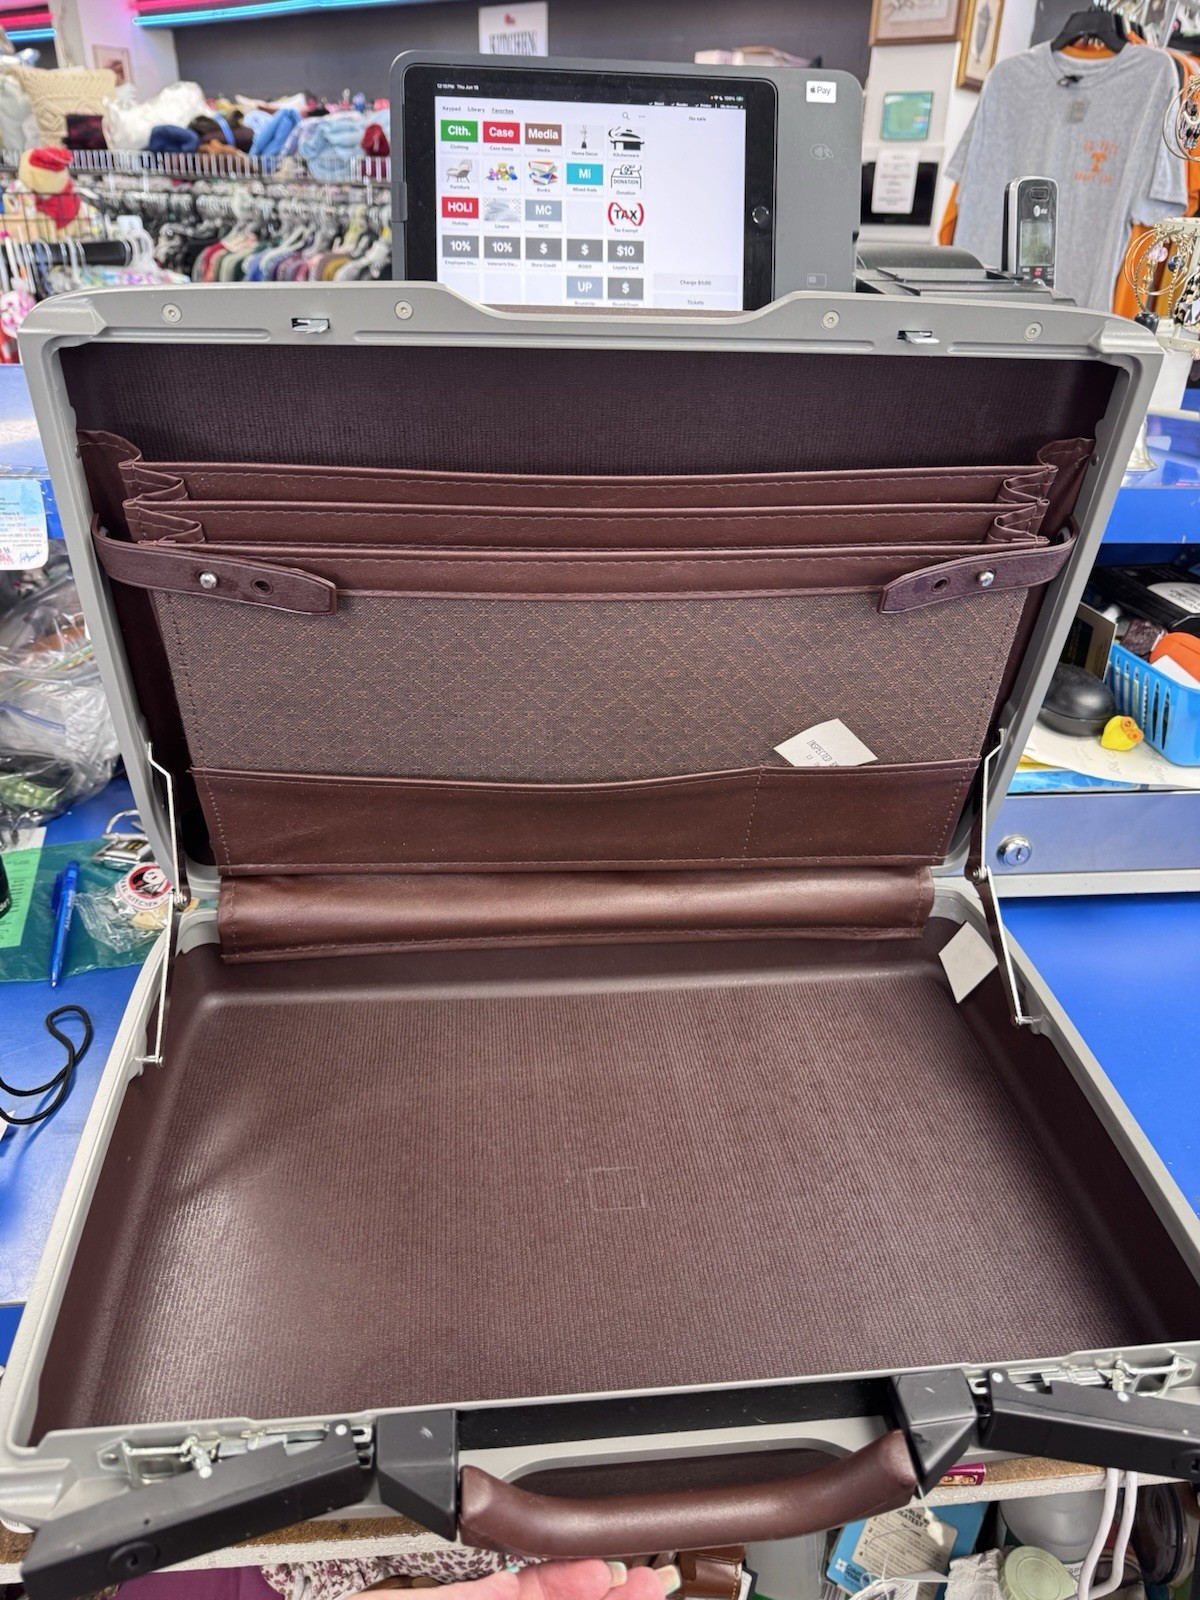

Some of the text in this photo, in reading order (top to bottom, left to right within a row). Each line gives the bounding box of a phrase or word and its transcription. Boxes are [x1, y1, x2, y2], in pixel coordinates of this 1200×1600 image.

[817, 86, 831, 96] Pay
[447, 125, 471, 136] Clth.
[489, 127, 514, 138] Case
[528, 128, 559, 139] Media
[579, 168, 591, 179] Mi
[447, 202, 473, 213] HOLI
[535, 204, 552, 215] MC
[614, 210, 638, 220] TAX
[450, 240, 471, 252] 10%
[492, 241, 512, 253] 10%
[540, 242, 548, 255] $
[581, 243, 589, 256] $
[616, 245, 635, 257] $10
[578, 282, 592, 293] UP
[622, 282, 629, 295] $
[806, 740, 833, 762] INSPECTED
